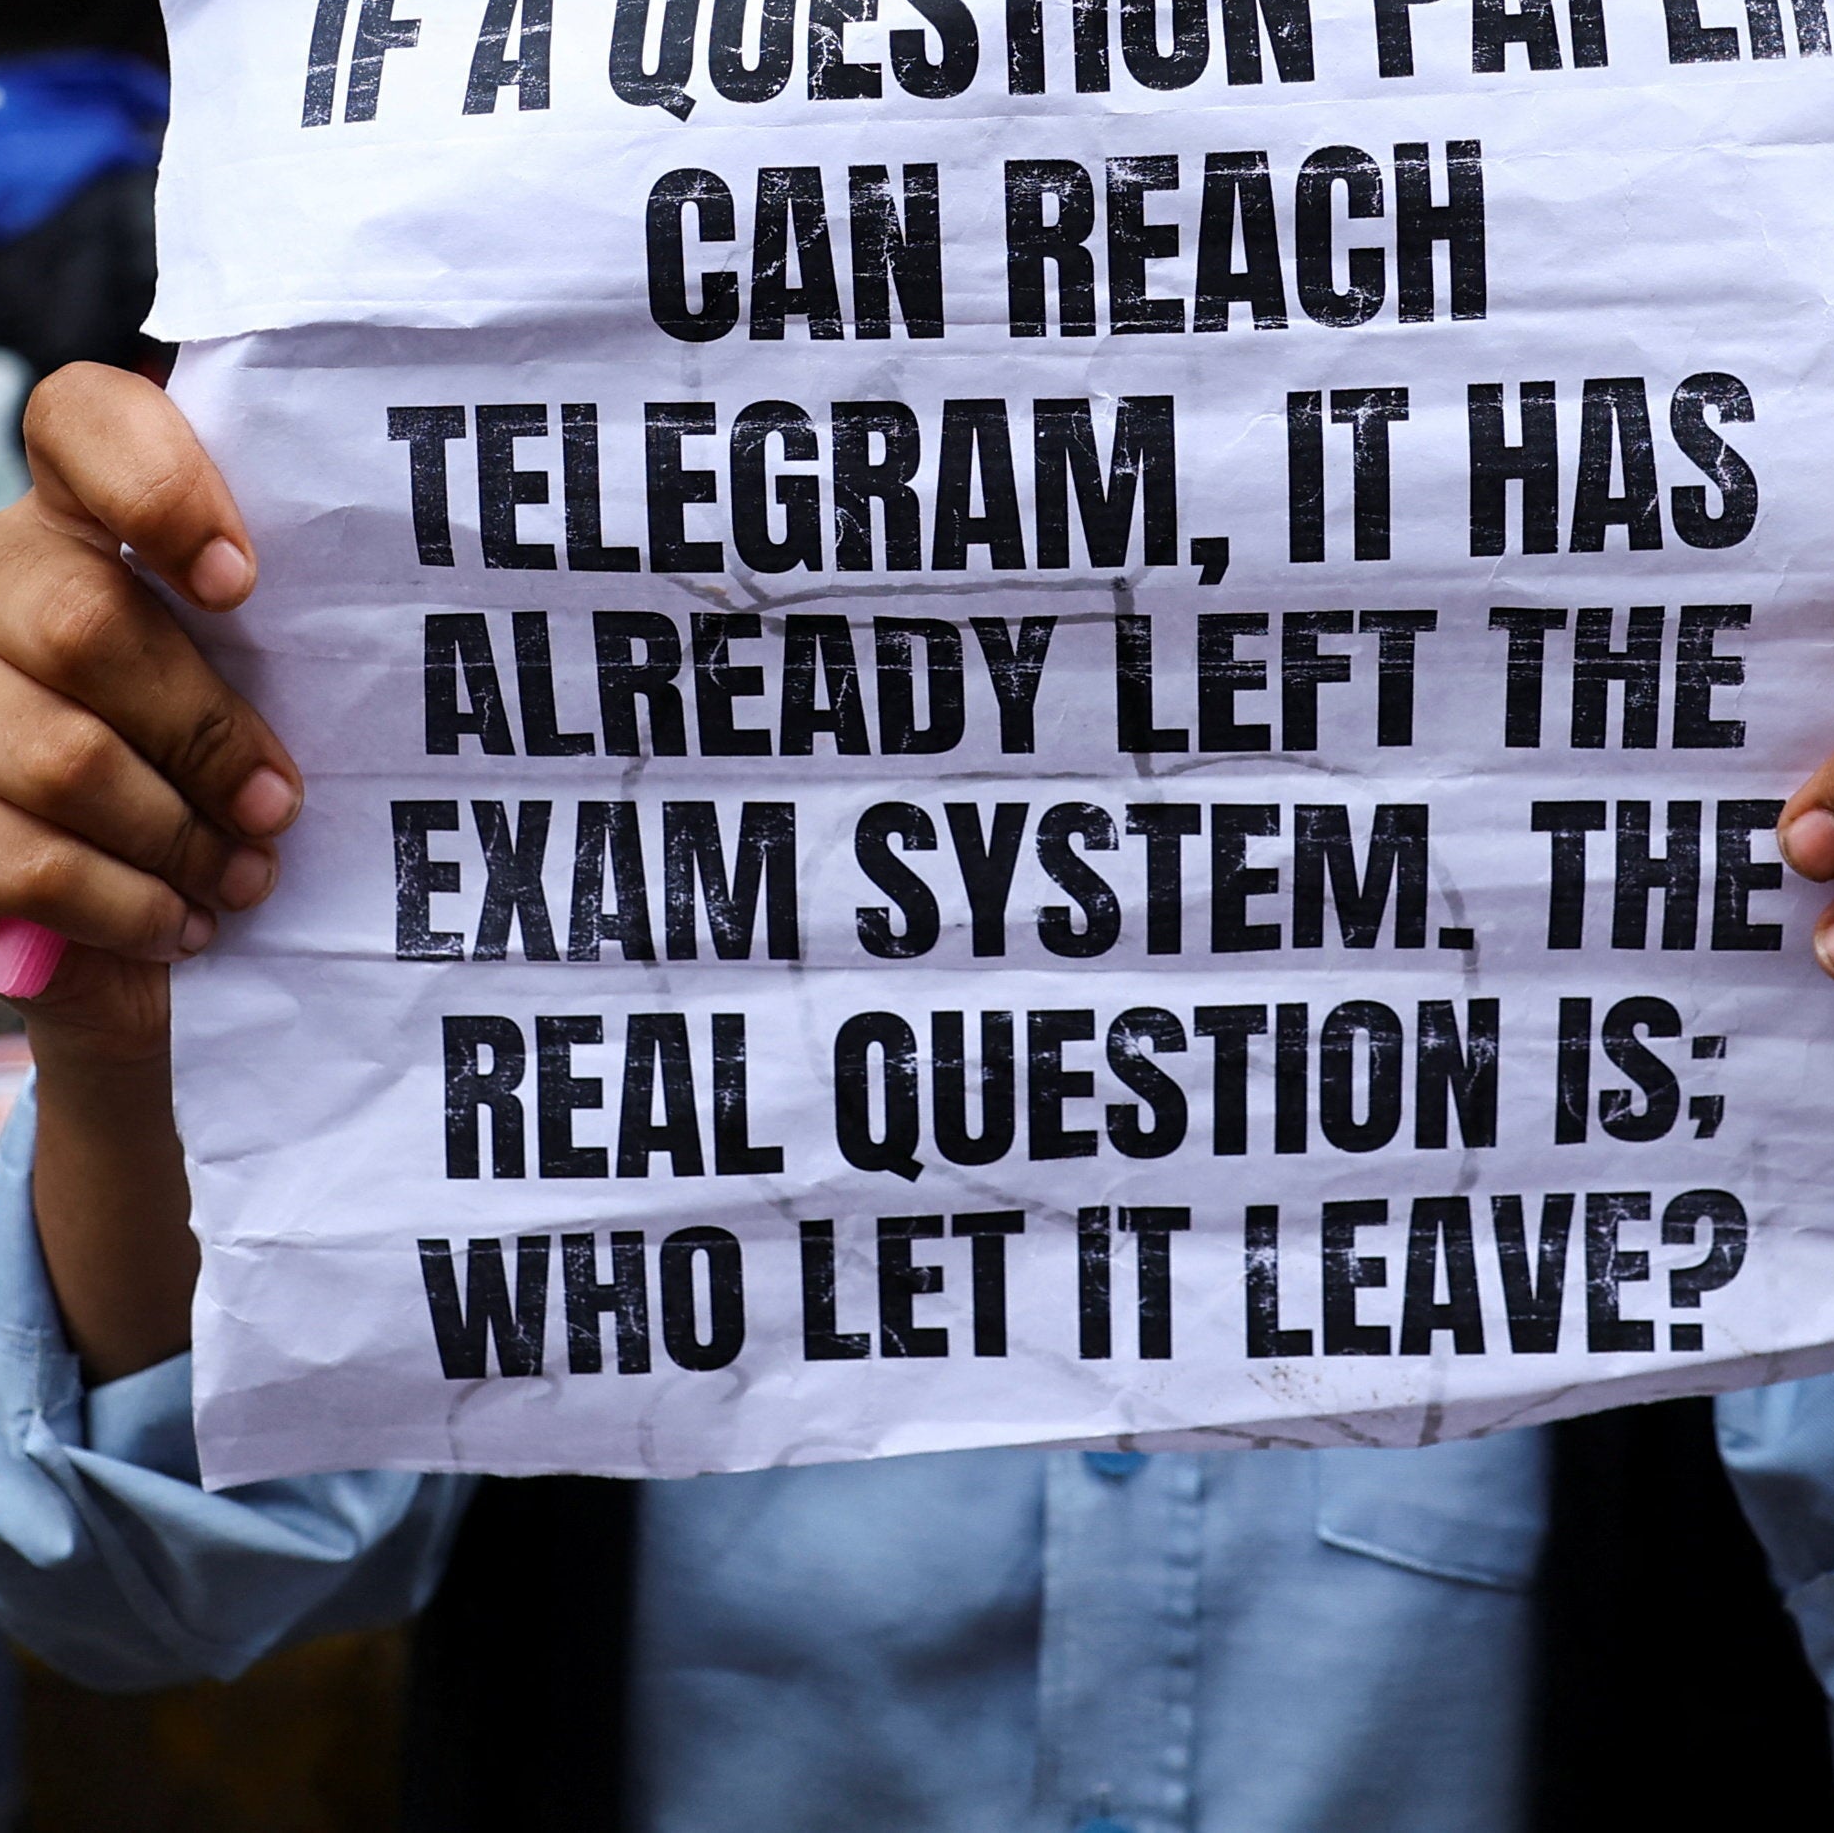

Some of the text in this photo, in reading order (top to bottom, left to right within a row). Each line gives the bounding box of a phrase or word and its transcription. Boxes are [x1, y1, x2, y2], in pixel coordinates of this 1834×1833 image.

[646, 139, 1486, 342] CAN REACH
[387, 372, 1758, 585] TELEGRAM, IT HAS
[424, 604, 1752, 758] ALREADY LEFT THE
[390, 800, 1785, 963] EXAM SYSTEM. THE
[442, 996, 1727, 1182] REAL QUESTION IS;
[418, 1189, 1747, 1380] WHO LET IT LEAVE?
